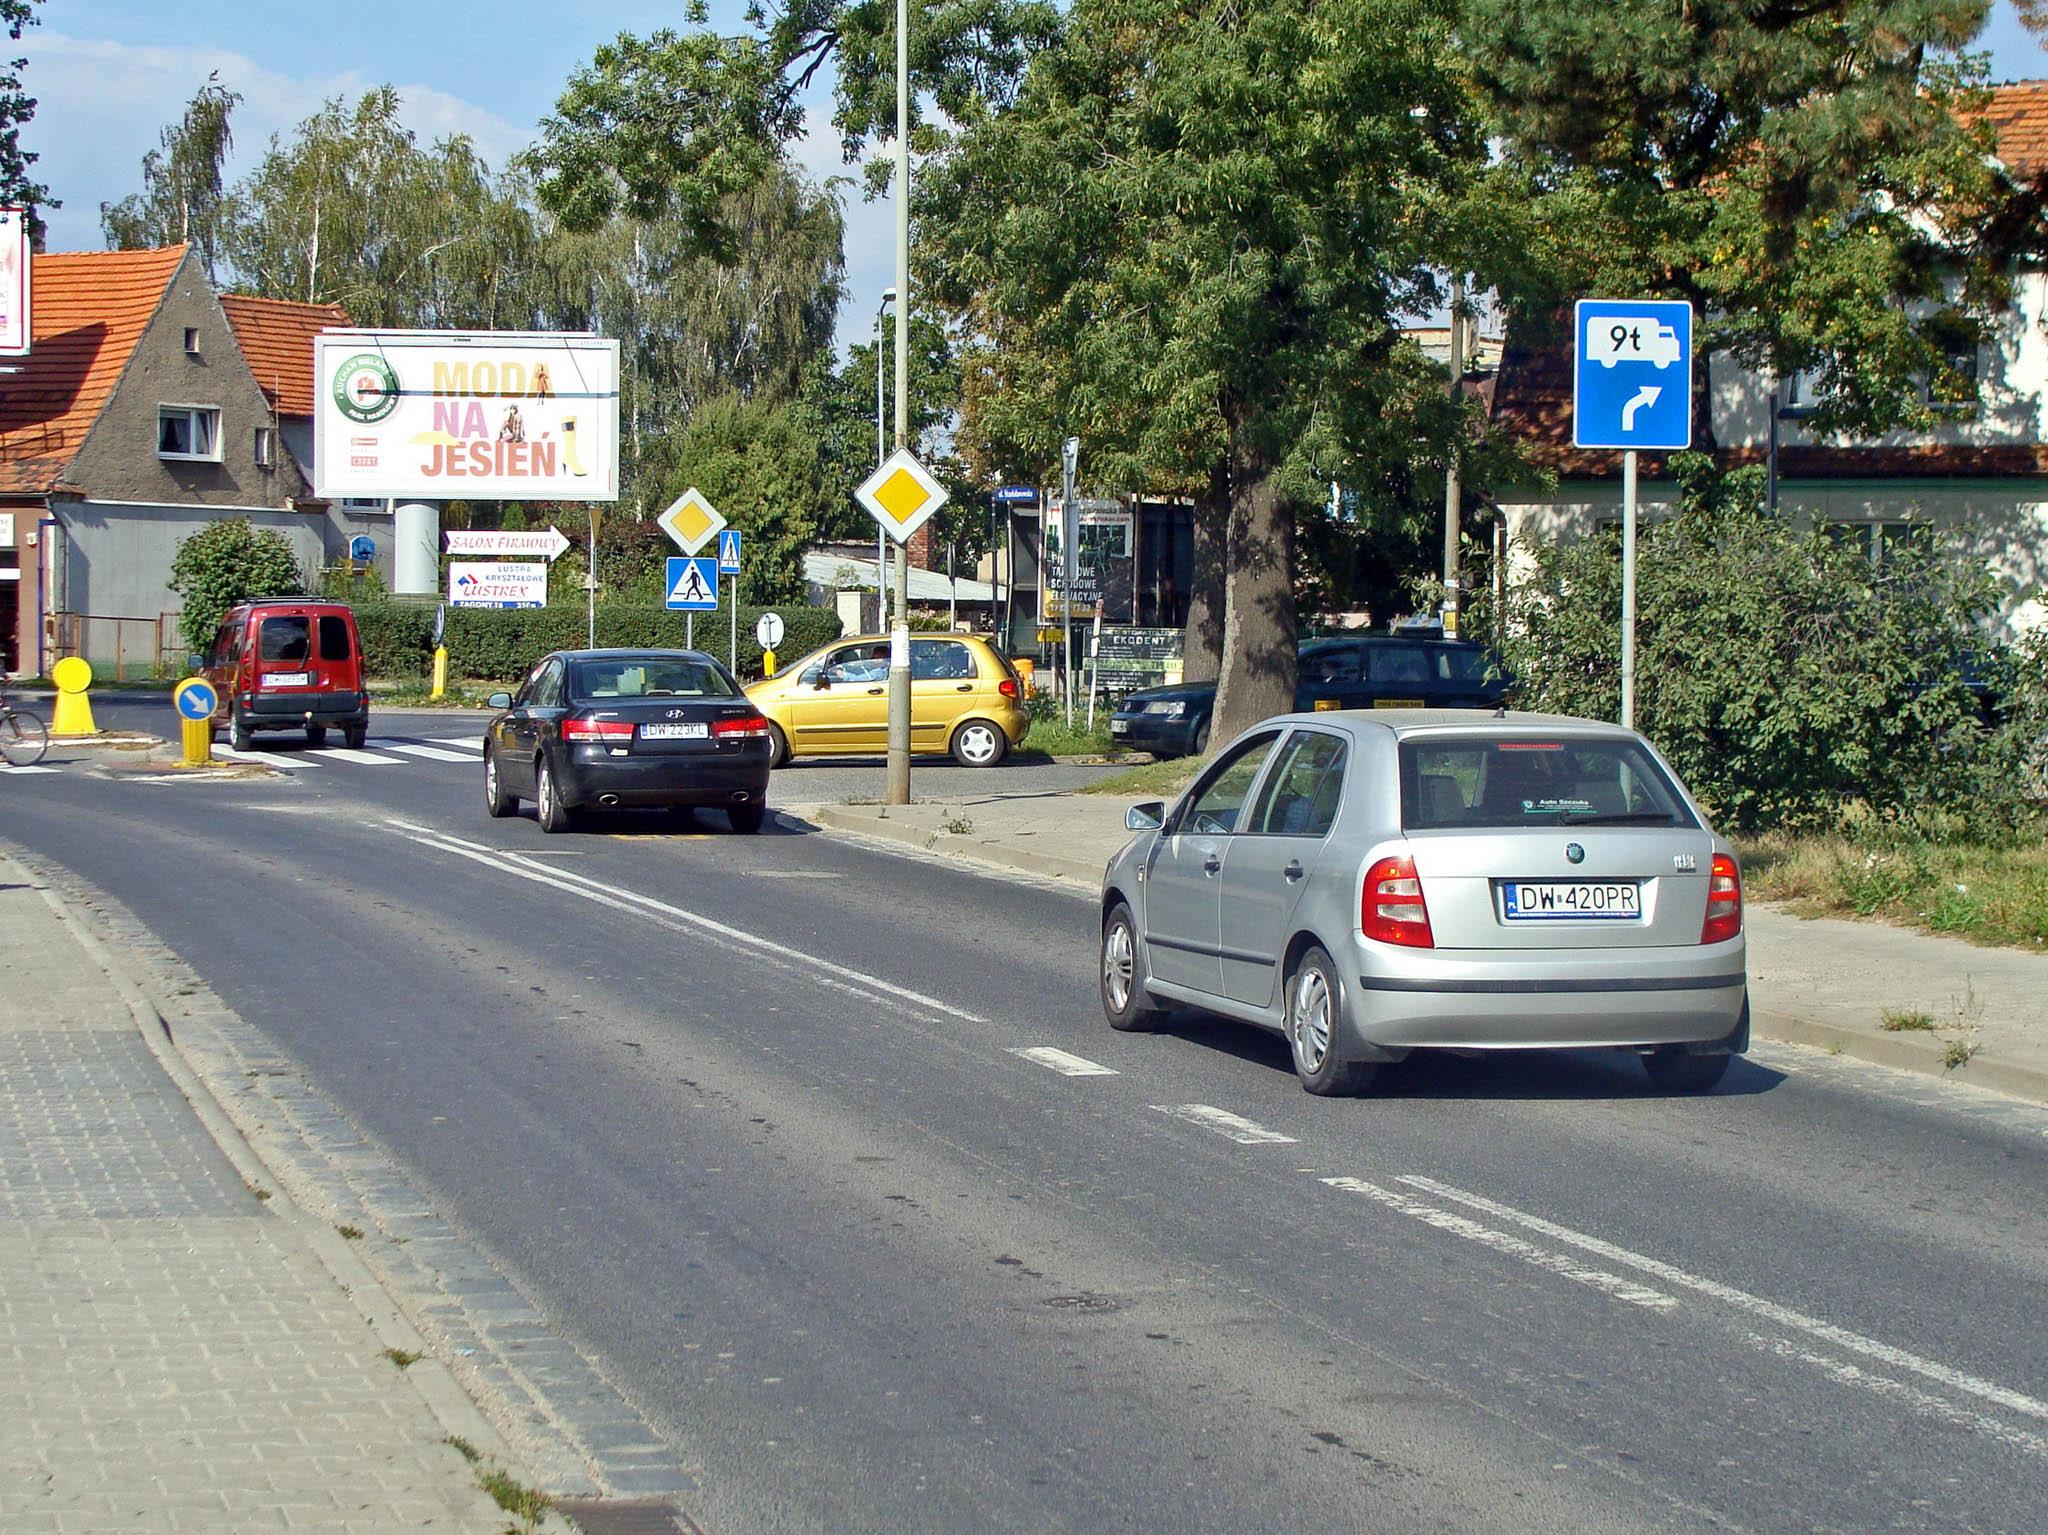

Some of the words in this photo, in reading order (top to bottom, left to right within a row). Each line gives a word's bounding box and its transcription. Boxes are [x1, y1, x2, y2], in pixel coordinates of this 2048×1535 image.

[1610, 325, 1641, 352] 9t
[432, 361, 556, 399] MODA
[433, 401, 489, 438] NA
[420, 432, 556, 477] JESIEŃ
[452, 537, 494, 549] SALON
[497, 537, 560, 551] FIRMOWY
[498, 565, 532, 573] LUSTRA
[1052, 567, 1095, 577] TAOWE
[485, 575, 544, 583] KRYSZTAŁOWE
[463, 585, 529, 597] LUSTREX
[1113, 636, 1166, 645] EKODENT
[649, 723, 666, 736] DW
[670, 723, 704, 736] 223KL
[1521, 887, 1554, 910] DW
[1565, 886, 1634, 910] 420PR
